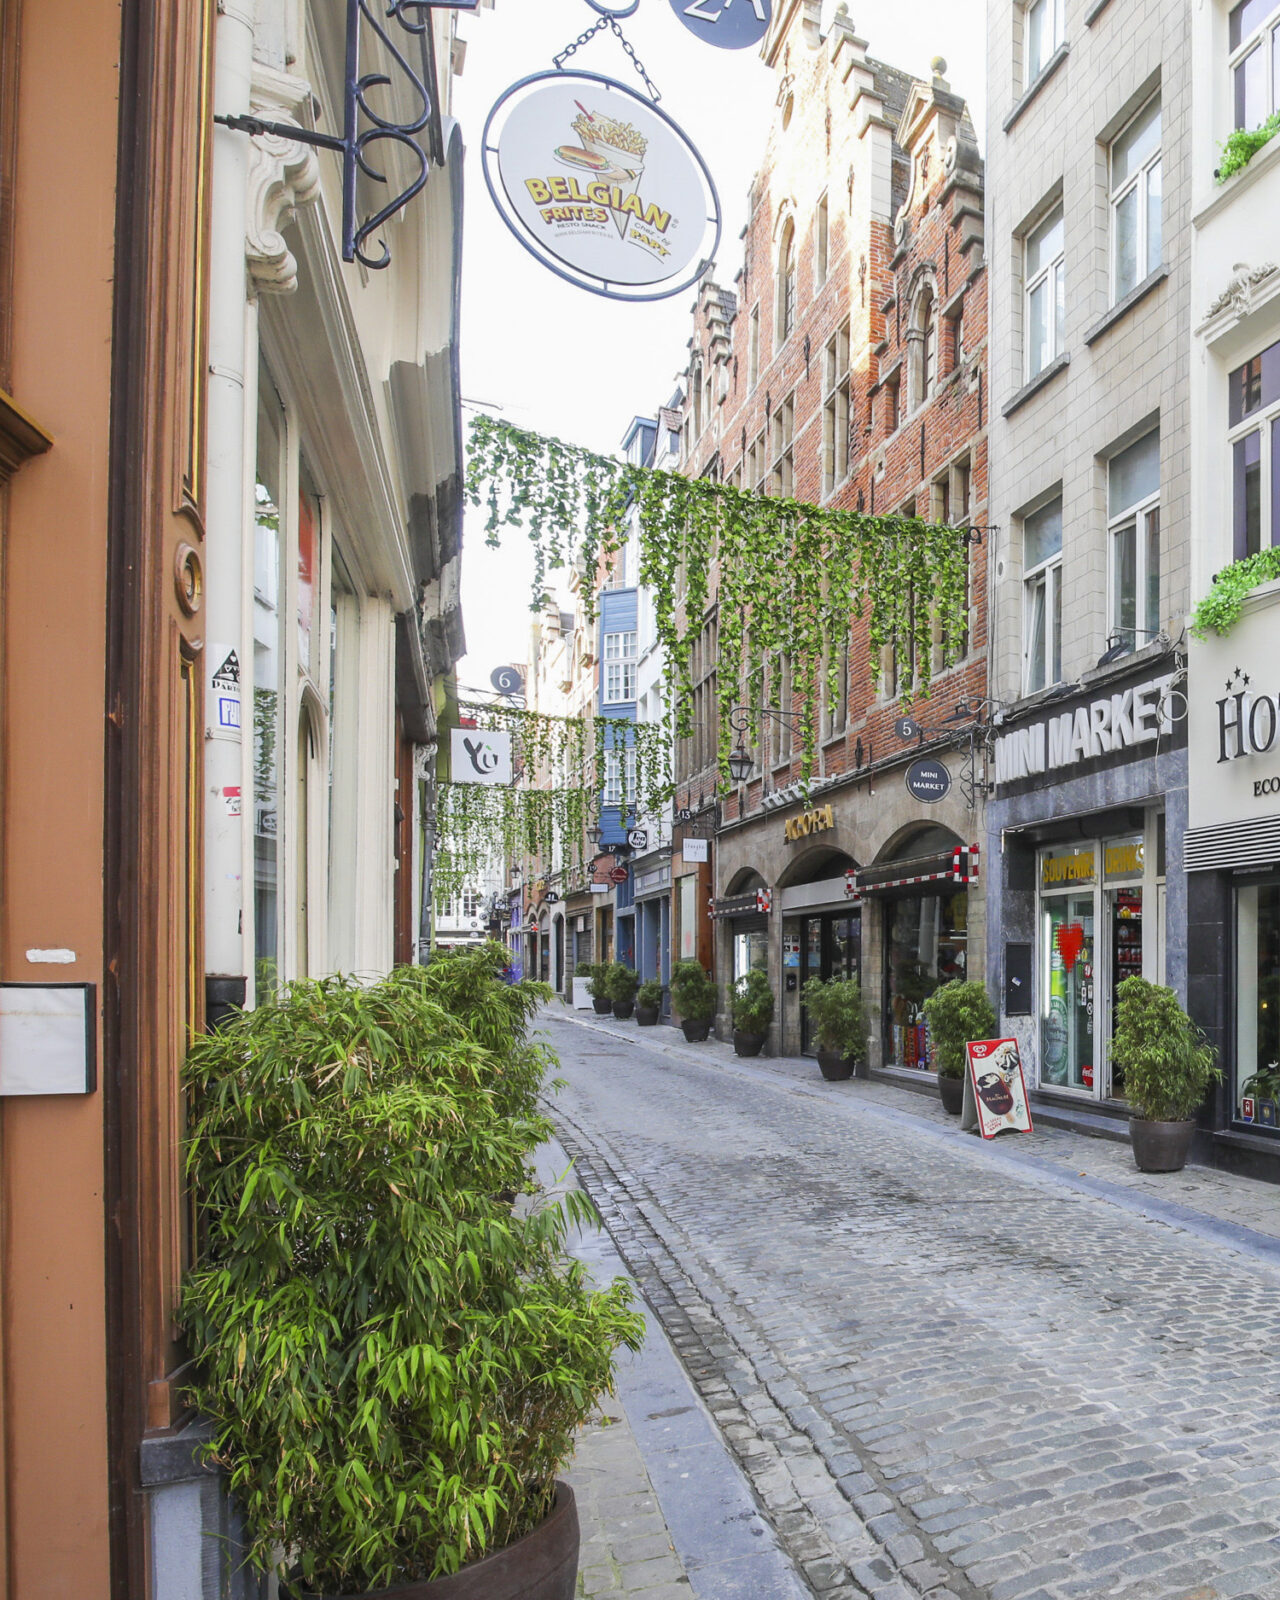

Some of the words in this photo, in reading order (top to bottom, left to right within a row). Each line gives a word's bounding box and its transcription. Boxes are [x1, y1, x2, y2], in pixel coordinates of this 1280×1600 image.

[524, 177, 672, 233] BELGIAN
[540, 206, 609, 225] FRITES
[630, 228, 671, 256] PAPY
[499, 671, 511, 688] 6
[902, 721, 912, 736] 5
[995, 722, 1046, 785] MINI
[1048, 672, 1174, 769] MARKET
[920, 771, 938, 779] MINI
[913, 781, 945, 790] MARKET
[1252, 776, 1280, 797] ECO
[681, 810, 691, 819] 13
